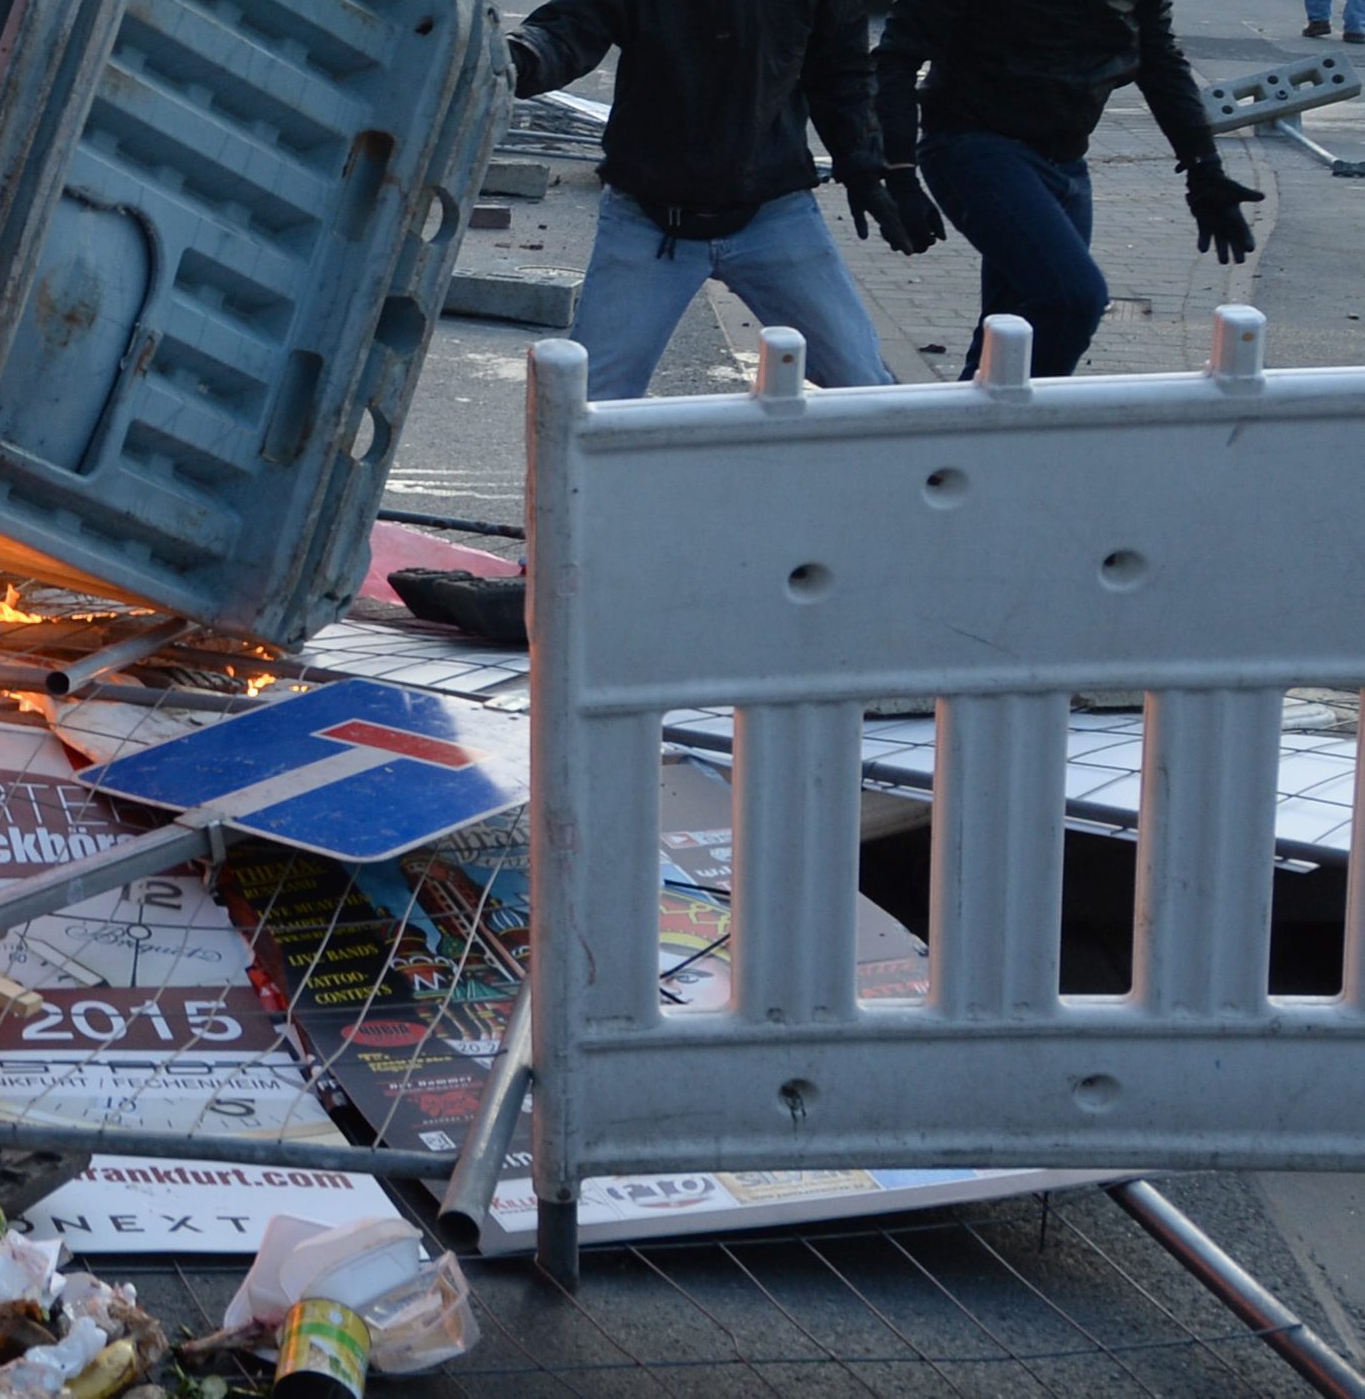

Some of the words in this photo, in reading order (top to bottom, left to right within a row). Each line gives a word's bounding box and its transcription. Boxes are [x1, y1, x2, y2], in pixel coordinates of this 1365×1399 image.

[328, 943, 380, 963] BANDS
[21, 1000, 245, 1043] 2015
[112, 1077, 281, 1091] FECHENHEIM
